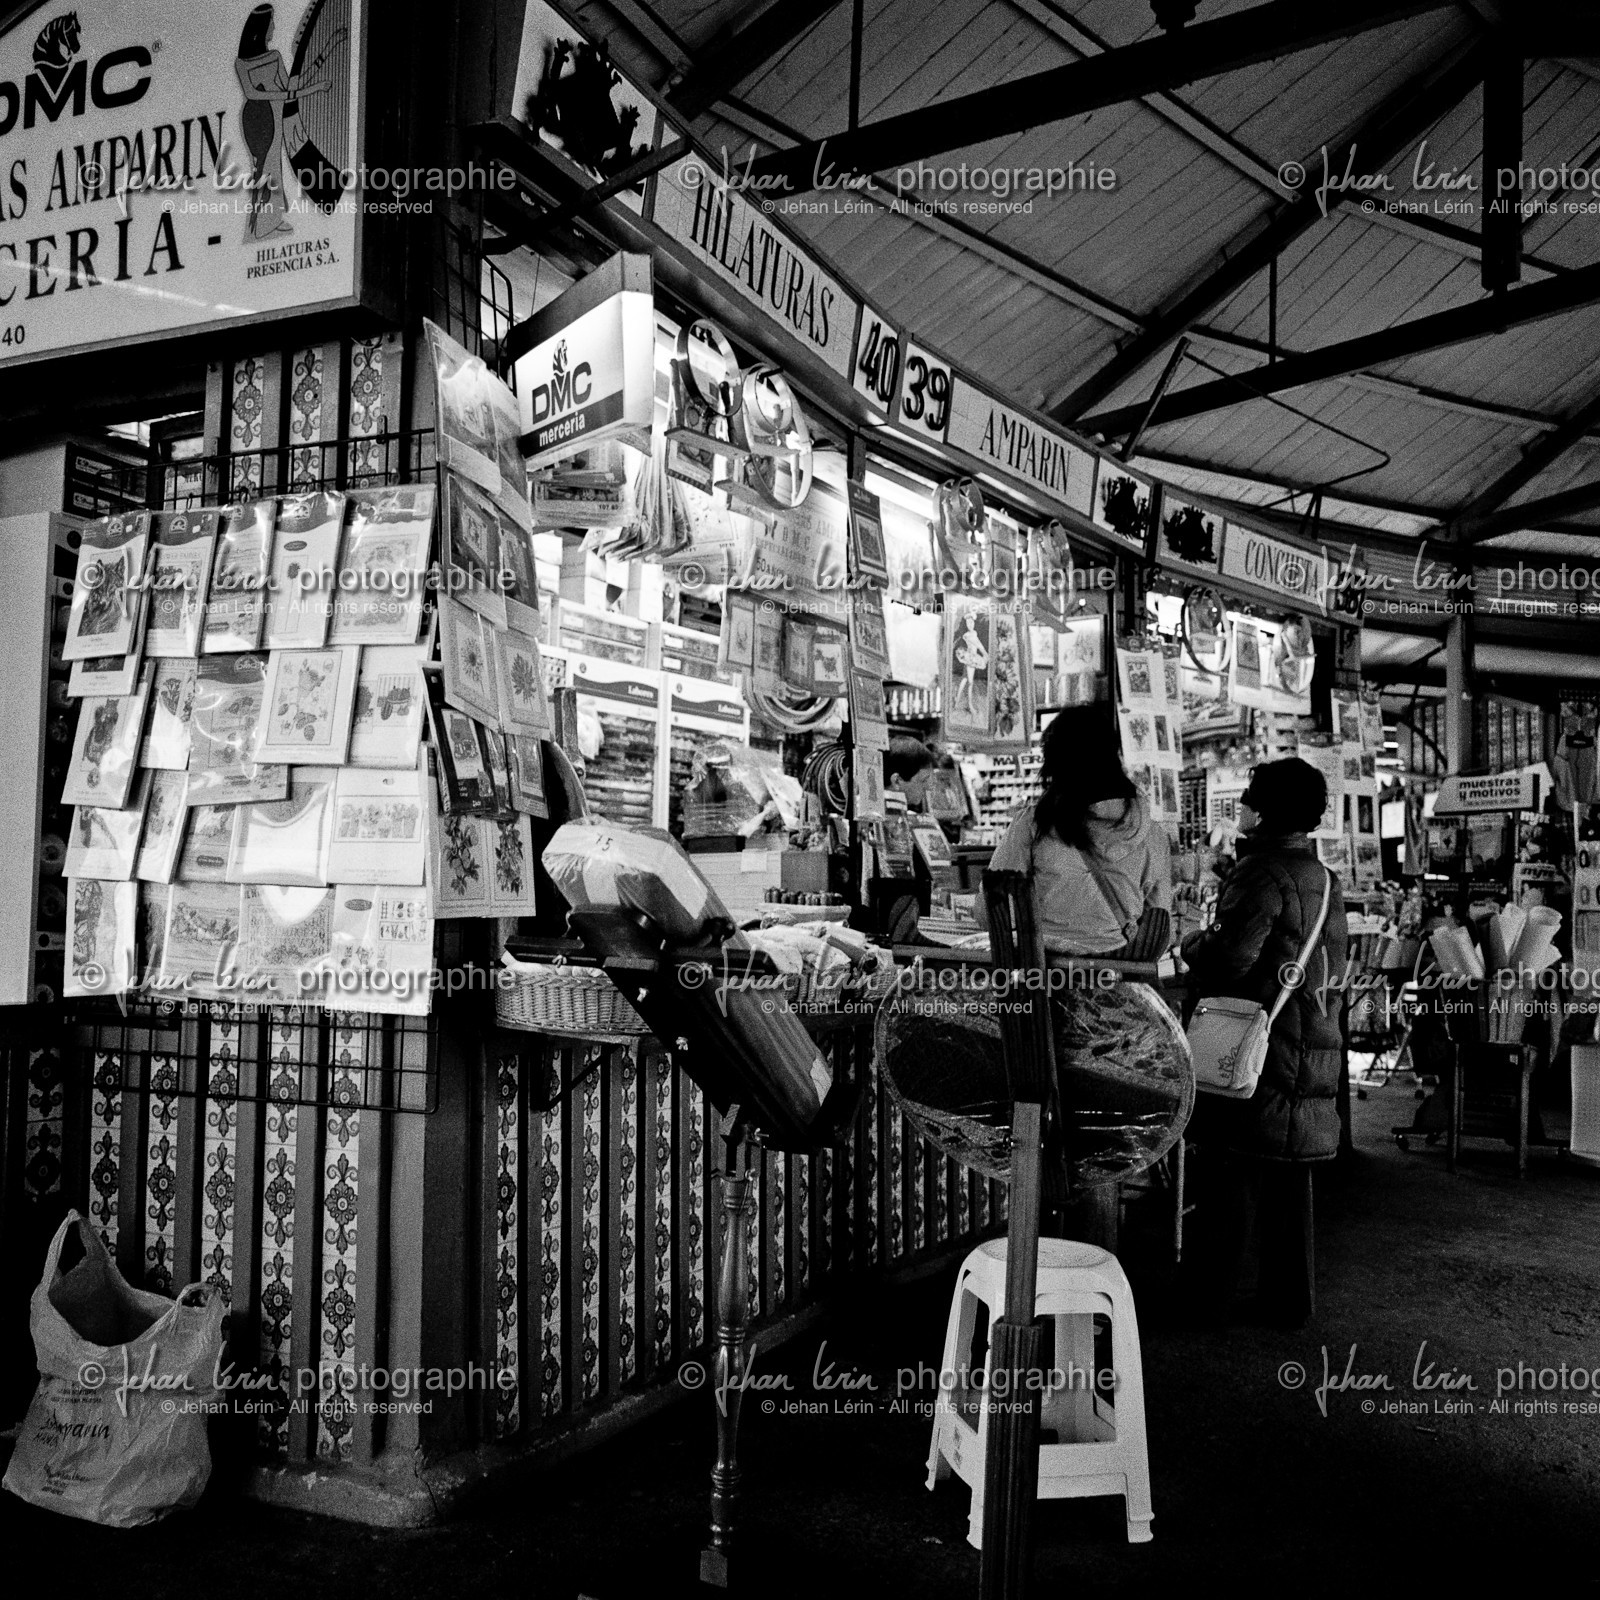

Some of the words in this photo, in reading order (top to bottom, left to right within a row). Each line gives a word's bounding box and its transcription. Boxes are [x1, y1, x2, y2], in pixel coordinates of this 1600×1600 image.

[0, 159, 28, 222] S
[45, 111, 226, 212] AMPARIN
[246, 254, 312, 279] PRESENCIA
[316, 252, 340, 267] S.A.
[256, 238, 330, 263] HILATURAS
[690, 174, 834, 348] HILATURAS
[532, 361, 592, 425] DMC
[859, 322, 899, 402] 40
[903, 356, 950, 431] 39
[539, 411, 586, 447] merceria
[980, 409, 1071, 495] AMPARIN
[1459, 779, 1520, 789] muestras
[1460, 791, 1467, 801] y
[1470, 788, 1520, 798] motivos
